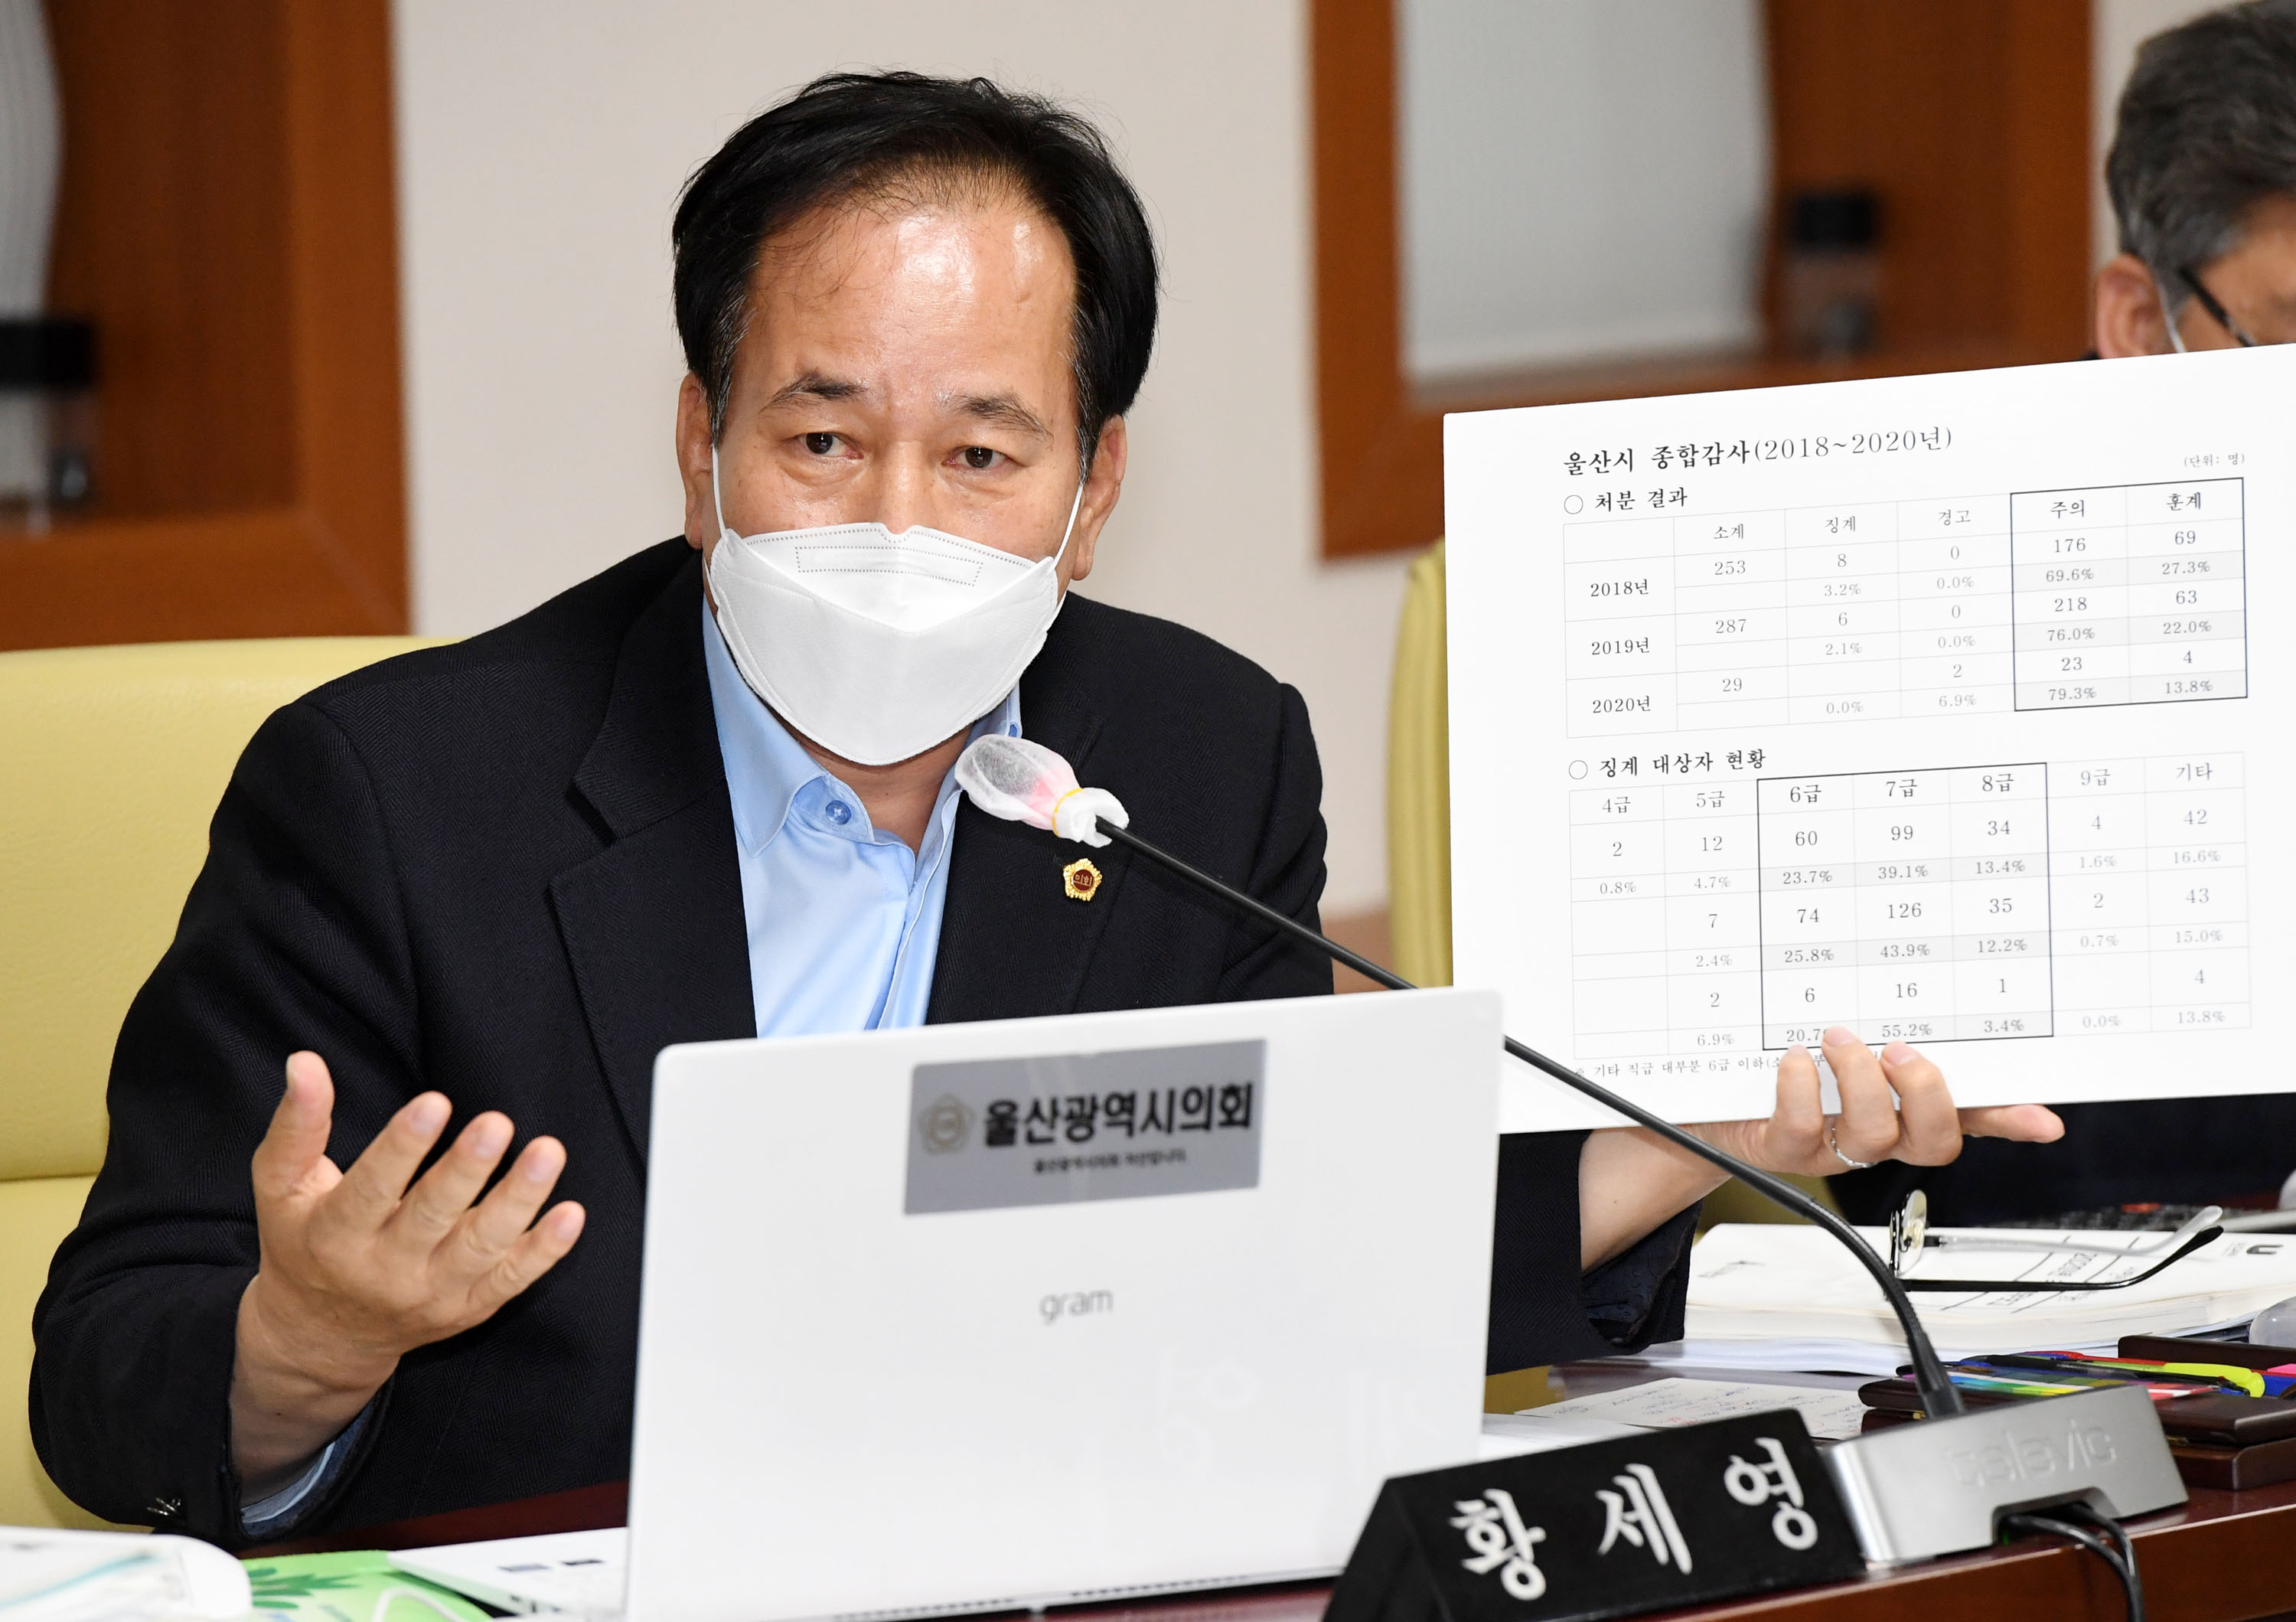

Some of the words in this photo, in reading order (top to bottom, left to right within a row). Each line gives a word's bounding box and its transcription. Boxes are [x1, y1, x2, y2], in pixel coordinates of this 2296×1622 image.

[1563, 448, 1633, 476] 울산시
[1650, 425, 1952, 470] 종합감사(2018~2020년)
[2183, 453, 2219, 468] (단위:
[2227, 452, 2245, 466] 명)
[1595, 490, 1636, 513] 처분
[1647, 486, 1688, 509] 결과
[1714, 523, 1744, 540] 소계
[1825, 515, 1856, 534] 징계
[1938, 508, 1971, 527] 경고
[2050, 499, 2085, 520] 주의
[2166, 491, 2201, 511] 훈계
[1714, 560, 1746, 576] 253
[1837, 553, 1848, 568] 8
[1950, 546, 1960, 560] 0
[2054, 537, 2086, 553] 176
[2174, 530, 2197, 546] 69
[1590, 578, 1649, 598] 2018년
[1824, 583, 1861, 597] 3.2%
[1936, 576, 1975, 590] 0.0%
[2045, 567, 2095, 583] 69.6%
[2161, 560, 2211, 576] 27.3%
[1715, 618, 1747, 634] 287
[1838, 612, 1848, 626] 6
[1951, 605, 1962, 619] 0
[2054, 596, 2087, 612] 218
[2175, 589, 2197, 605] 63
[1591, 636, 1651, 656] 2019년
[1825, 642, 1862, 656] 2.1%
[1937, 635, 1976, 649] 0.0%
[2047, 627, 2095, 642] 76.0%
[2163, 620, 2212, 635] 22.0%
[1722, 677, 1743, 693] 29
[1952, 664, 1962, 678] 2
[2061, 656, 2082, 671] 23
[2183, 650, 2193, 664] 4
[1592, 694, 1652, 714] 2020년
[1826, 700, 1864, 715] 0.0%
[1939, 694, 1977, 708] 6.9%
[2048, 687, 2097, 701] 79.3%
[2165, 679, 2213, 694] 13.8%
[1599, 756, 1638, 778] 징계
[1652, 751, 1714, 775] 대상자
[1726, 748, 1766, 770] 현황
[1602, 796, 1632, 814] 4급
[1696, 790, 1726, 808] 5급
[1789, 784, 1822, 804] 6급
[1886, 778, 1918, 798] 7급
[1981, 772, 2015, 793] 8급
[2080, 768, 2112, 787] 9급
[2176, 762, 2213, 782] 기타
[1612, 841, 1623, 857] 2
[1702, 835, 1723, 852] 12
[1795, 830, 1818, 847] 60
[1890, 825, 1914, 841] 99
[1987, 820, 2011, 836] 34
[2091, 814, 2101, 831] 4
[2183, 809, 2207, 825] 42
[1600, 881, 1636, 895] 0.8%
[1693, 876, 1732, 890] 4.7%
[1782, 870, 1833, 885] 23.7%
[1877, 864, 1929, 880] 39.1%
[1975, 859, 2026, 875] 13.4%
[2079, 855, 2118, 869] 1.6%
[2174, 850, 2222, 865] 16.6%
[1708, 913, 1718, 928] 7
[1797, 908, 1819, 924] 74
[1888, 902, 1922, 919] 126
[1989, 897, 2013, 914] 35
[2093, 893, 2104, 909] 2
[2185, 887, 2210, 904] 43
[1695, 954, 1733, 968] 2.4%
[1784, 948, 1835, 963] 25.8%
[1880, 943, 1930, 958] 43.9%
[1977, 938, 2027, 954] 12.2%
[2079, 934, 2119, 948] 0.7%
[2175, 929, 2223, 944] 15.0%
[1710, 992, 1720, 1008] 2
[1805, 987, 1815, 1003] 6
[1896, 982, 1918, 998] 16
[1999, 977, 2007, 994] 1
[2194, 969, 2205, 984] 4
[1697, 1033, 1733, 1047] 6.9%
[1786, 1028, 1828, 1043] 20.7
[1881, 1023, 1932, 1038] 55.2%
[1983, 1018, 2025, 1033] 3.4%
[2082, 1015, 2121, 1028] 0.0%
[2178, 1010, 2226, 1024] 13.8%
[1594, 1063, 1620, 1078] 기타
[1628, 1062, 1654, 1076] 직급
[1661, 1059, 1701, 1075] 대부분
[1708, 1059, 1730, 1072] 6급
[985, 1082, 1254, 1148] 울산광역시의회
[1039, 1289, 1114, 1324] gram
[1945, 1418, 2117, 1488] televic
